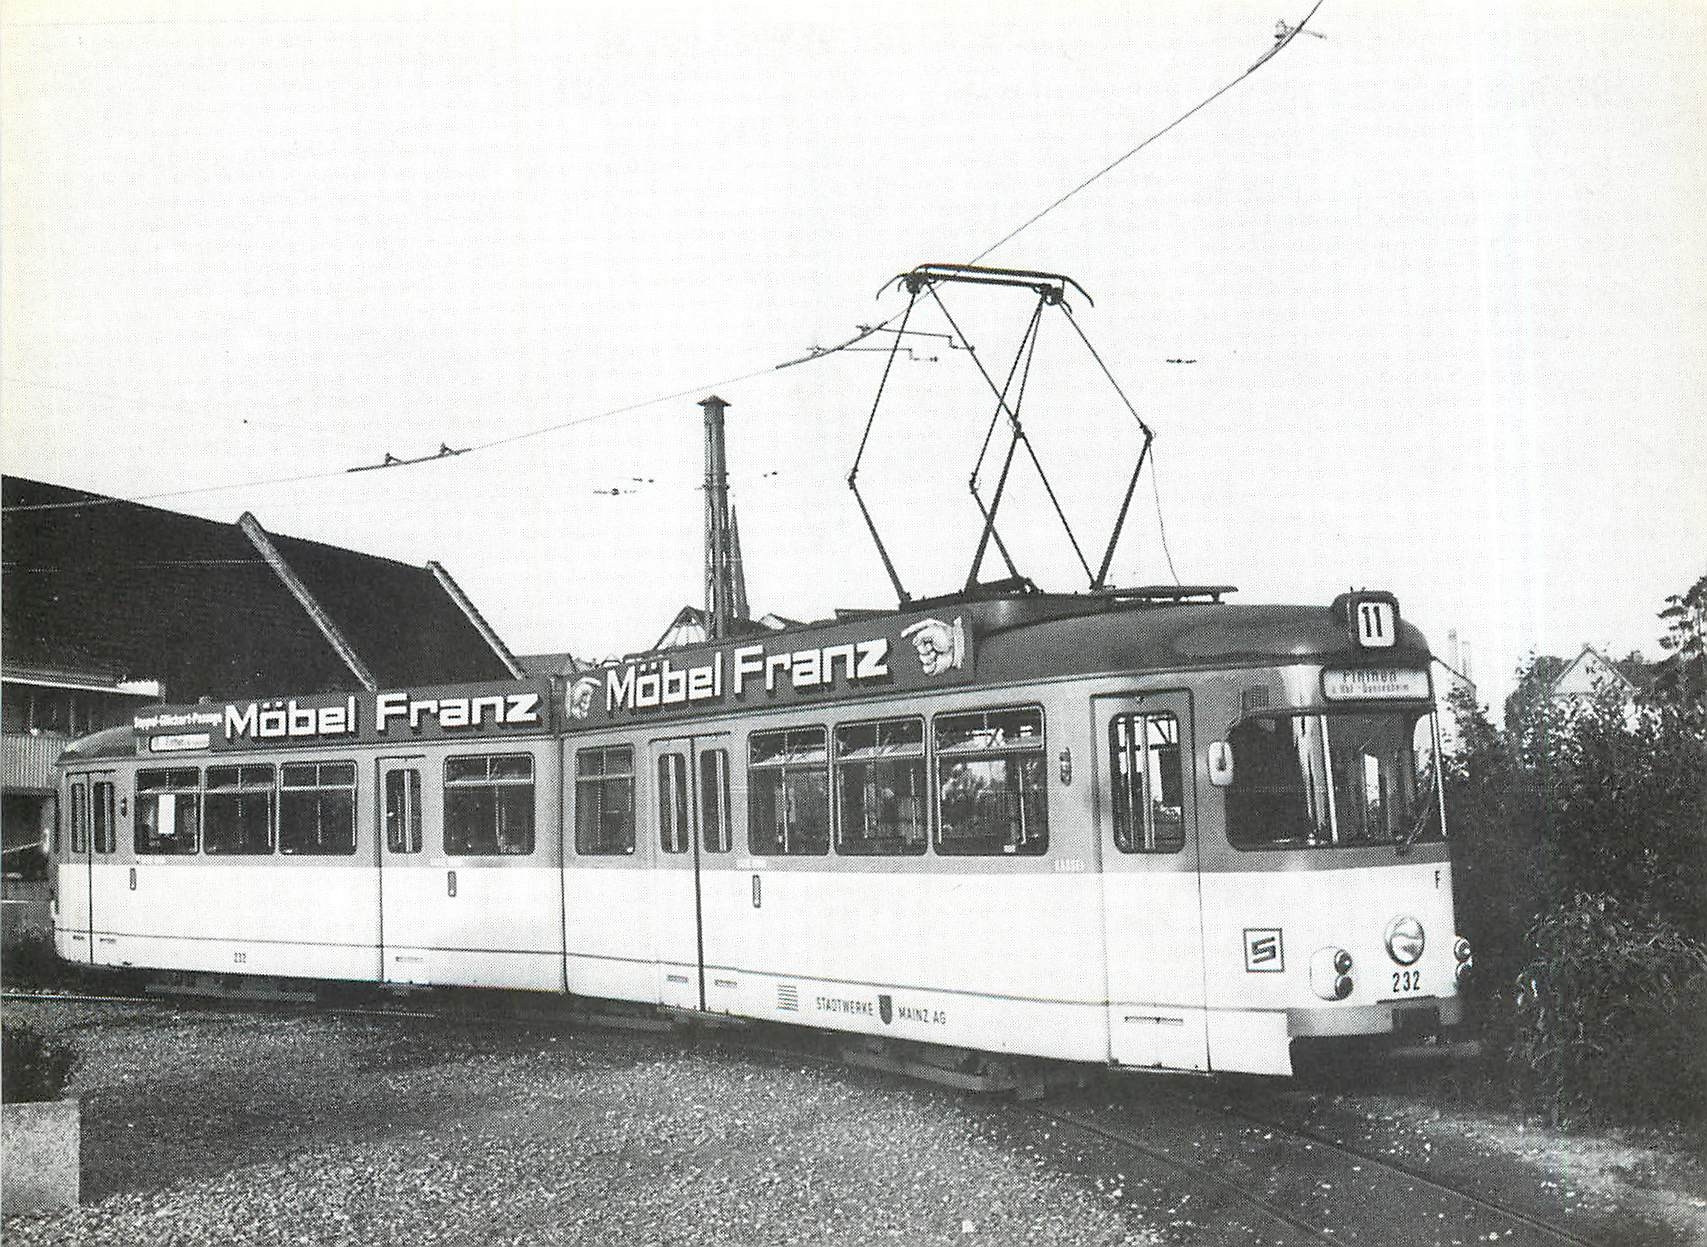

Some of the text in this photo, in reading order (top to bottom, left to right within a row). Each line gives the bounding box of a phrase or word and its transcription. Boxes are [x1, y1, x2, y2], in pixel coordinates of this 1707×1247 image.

[1361, 605, 1382, 637] 11
[605, 639, 888, 711] Möbel Franz
[225, 694, 356, 739] Möbel
[376, 692, 539, 731] Franz
[1434, 870, 1441, 888] F
[1392, 971, 1421, 993] 232
[816, 997, 947, 1025] STADTWERKE MAINZ AG
